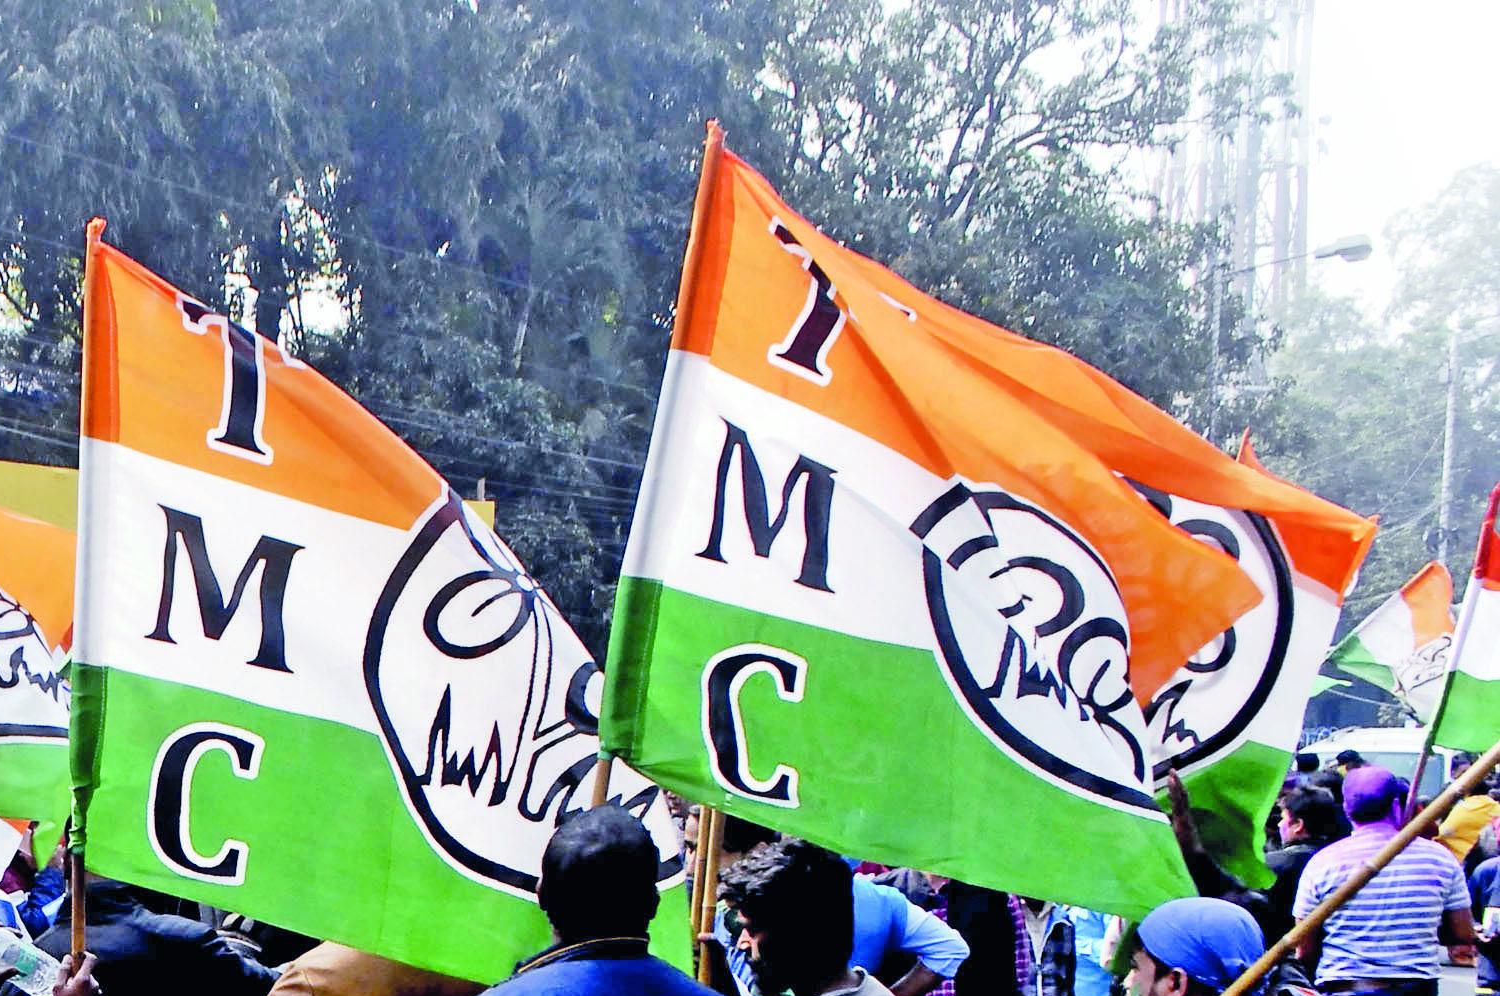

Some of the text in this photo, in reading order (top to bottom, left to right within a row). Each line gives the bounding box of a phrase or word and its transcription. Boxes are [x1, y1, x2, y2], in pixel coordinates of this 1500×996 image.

[143, 502, 306, 674] M
[694, 417, 838, 594] M
[146, 721, 265, 886] C
[701, 643, 808, 807] C
